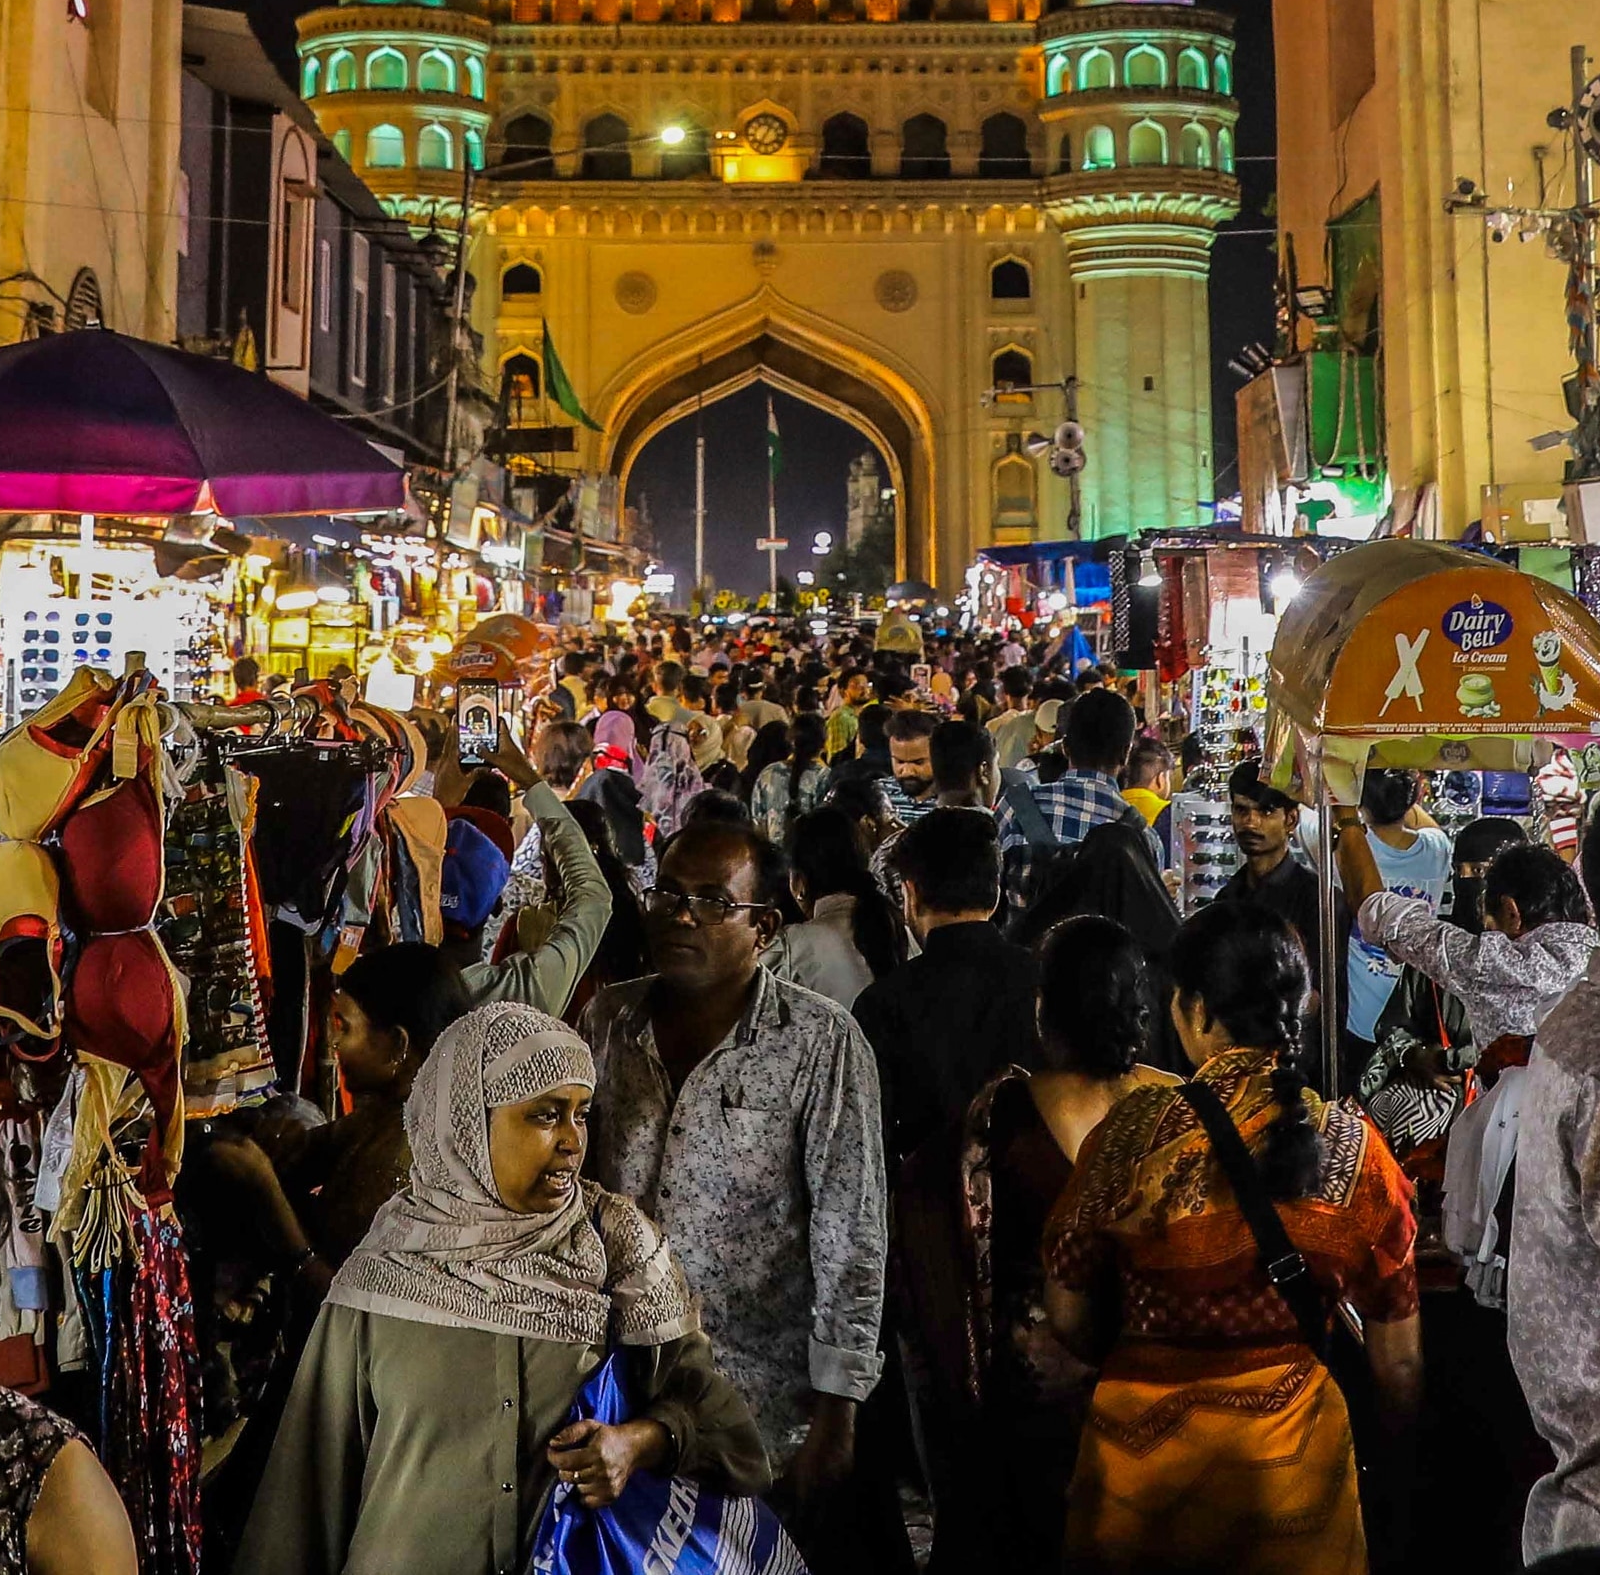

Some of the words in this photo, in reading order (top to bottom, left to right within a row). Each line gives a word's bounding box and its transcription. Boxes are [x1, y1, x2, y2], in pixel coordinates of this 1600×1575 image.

[1448, 609, 1506, 634] Dairy
[1452, 651, 1470, 663] Ice
[1470, 651, 1508, 663] Cream
